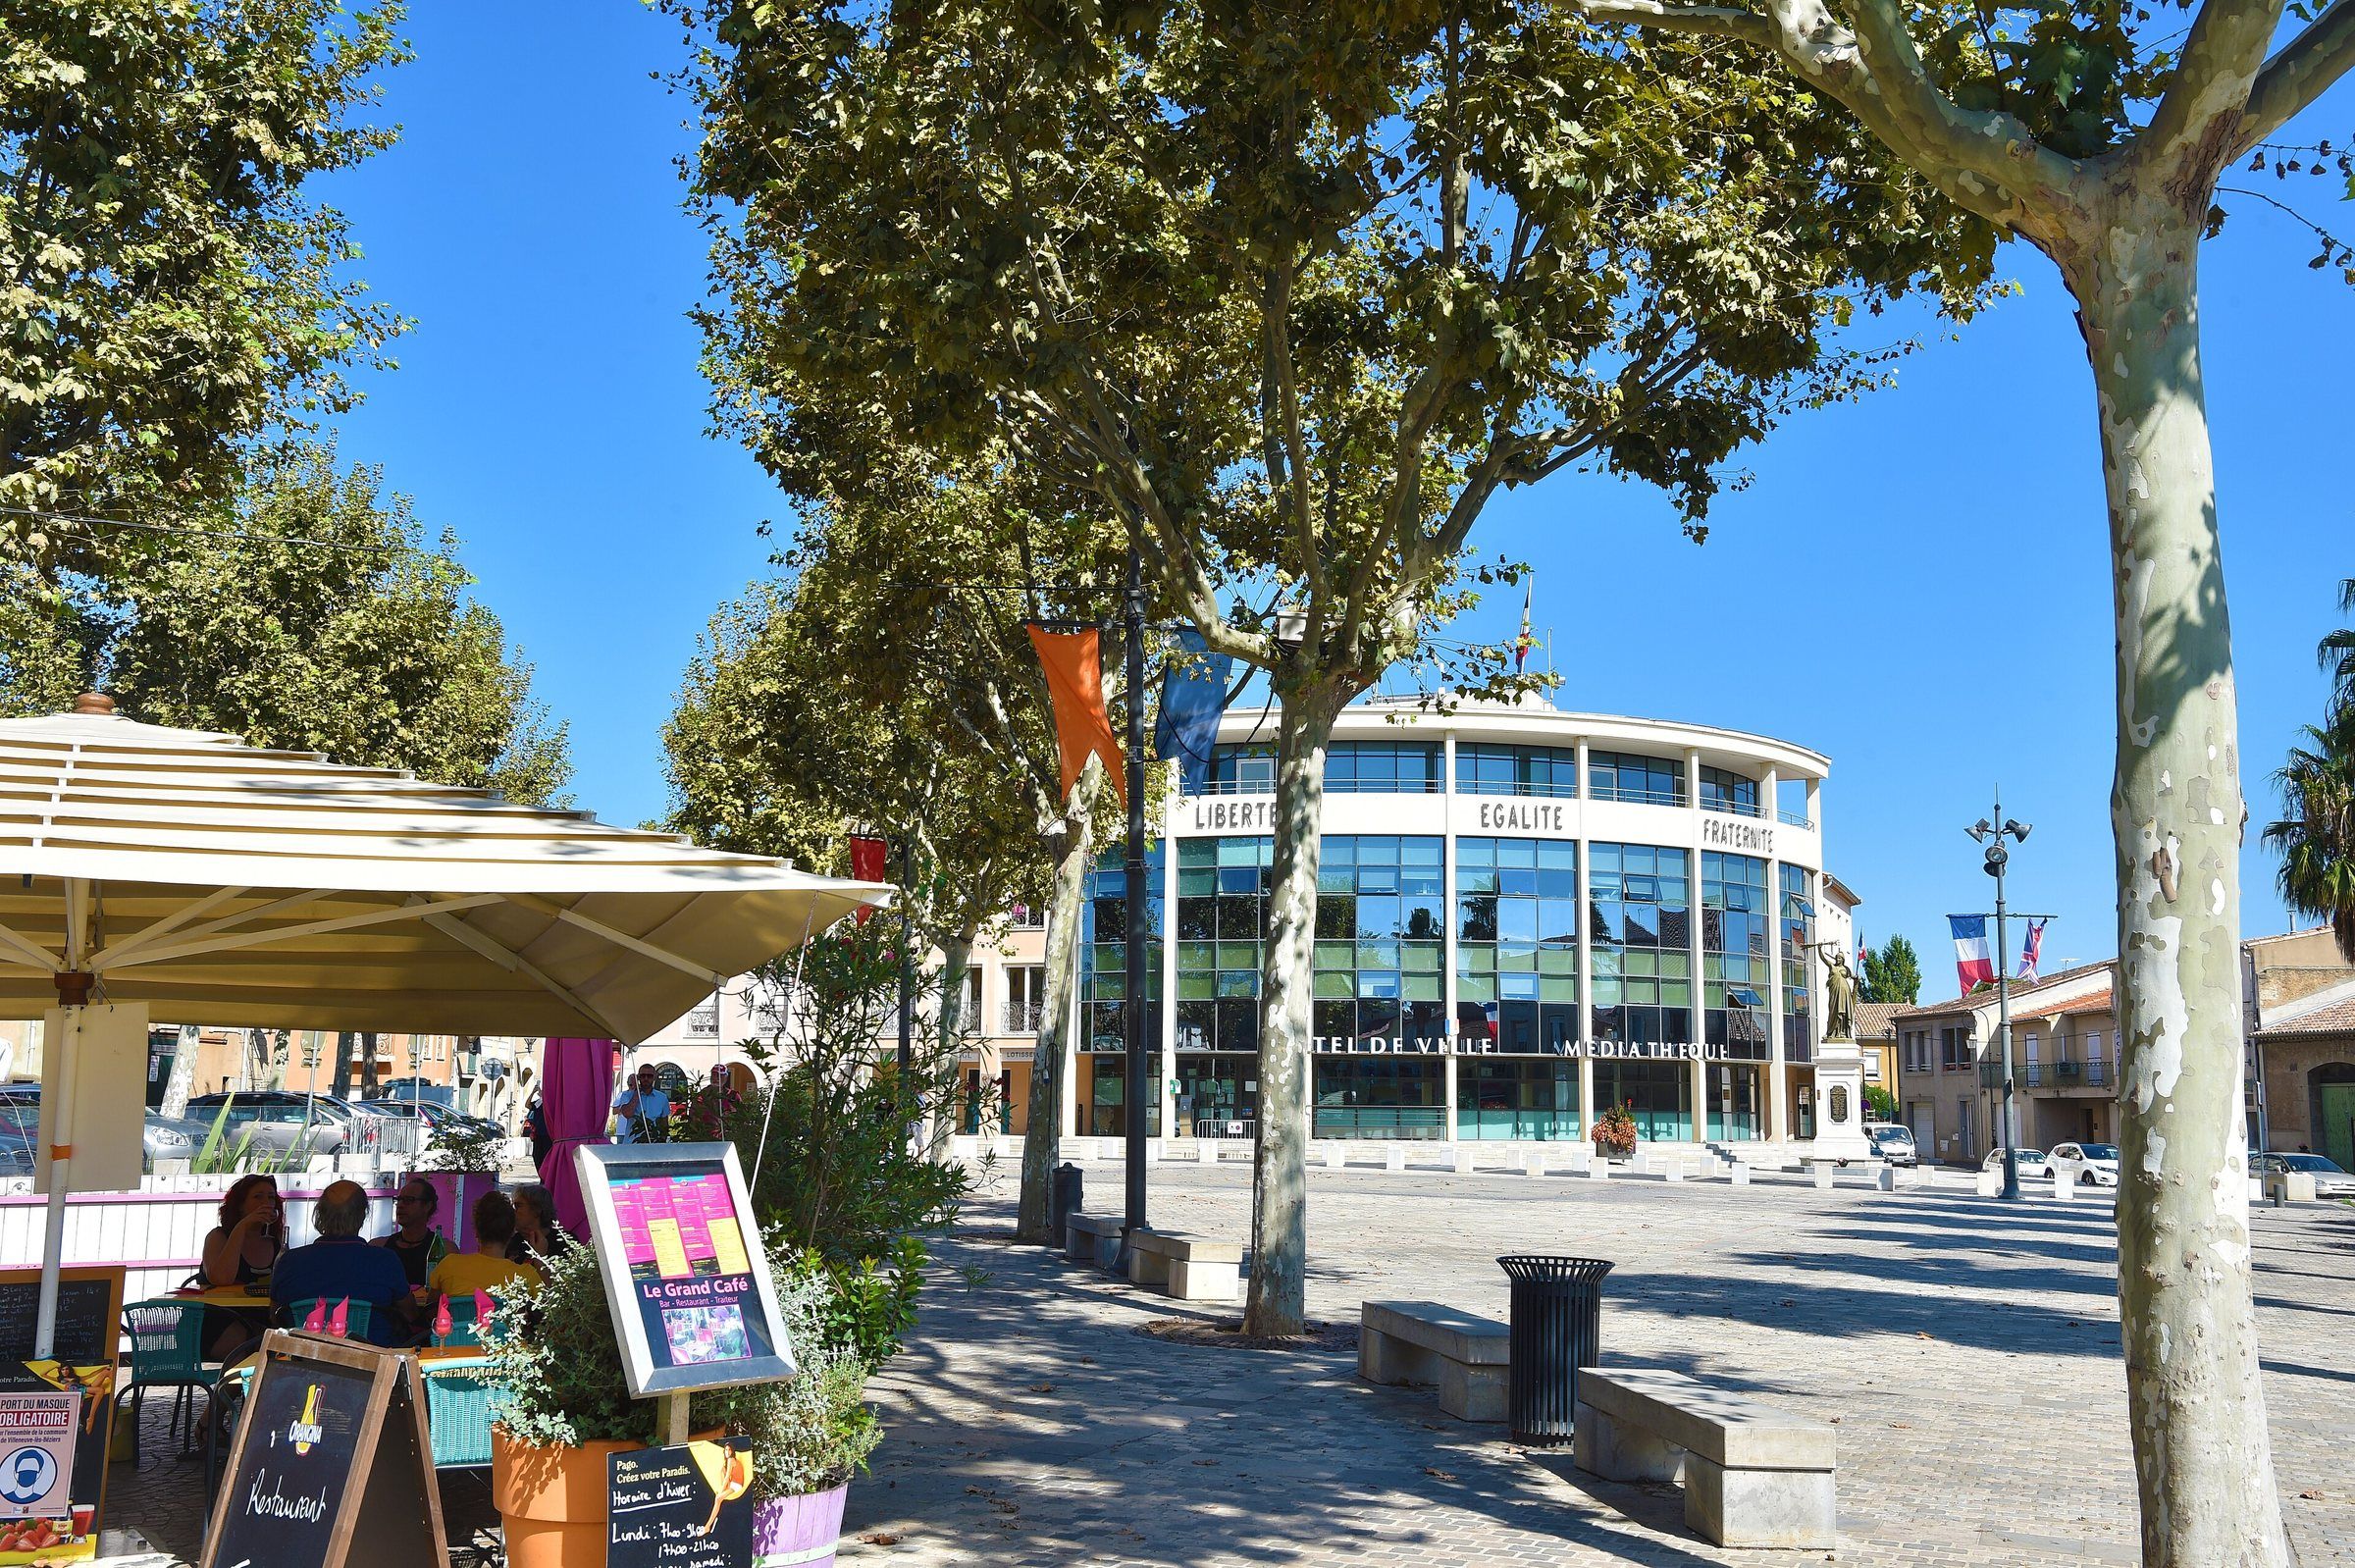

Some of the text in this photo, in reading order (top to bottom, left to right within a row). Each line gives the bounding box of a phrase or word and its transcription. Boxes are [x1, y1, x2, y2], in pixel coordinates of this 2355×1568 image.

[1195, 802, 1276, 830] LIBERTE
[1480, 803, 1563, 831] EGALITE
[1703, 818, 1773, 854] FRATERNITE
[1313, 1036, 1358, 1055] TEL
[1370, 1036, 1403, 1055] DE
[643, 1277, 749, 1298] Le Grand Café
[676, 1297, 709, 1307] Restaurant
[1, 1398, 71, 1410] PORT DU MASQUE
[0, 1412, 68, 1427] OBLIGATOIRE
[616, 1460, 639, 1471] Pago.
[616, 1465, 691, 1485] Créez votre Paradis.
[246, 1468, 327, 1524] Restaurant
[612, 1490, 652, 1507] Horaire
